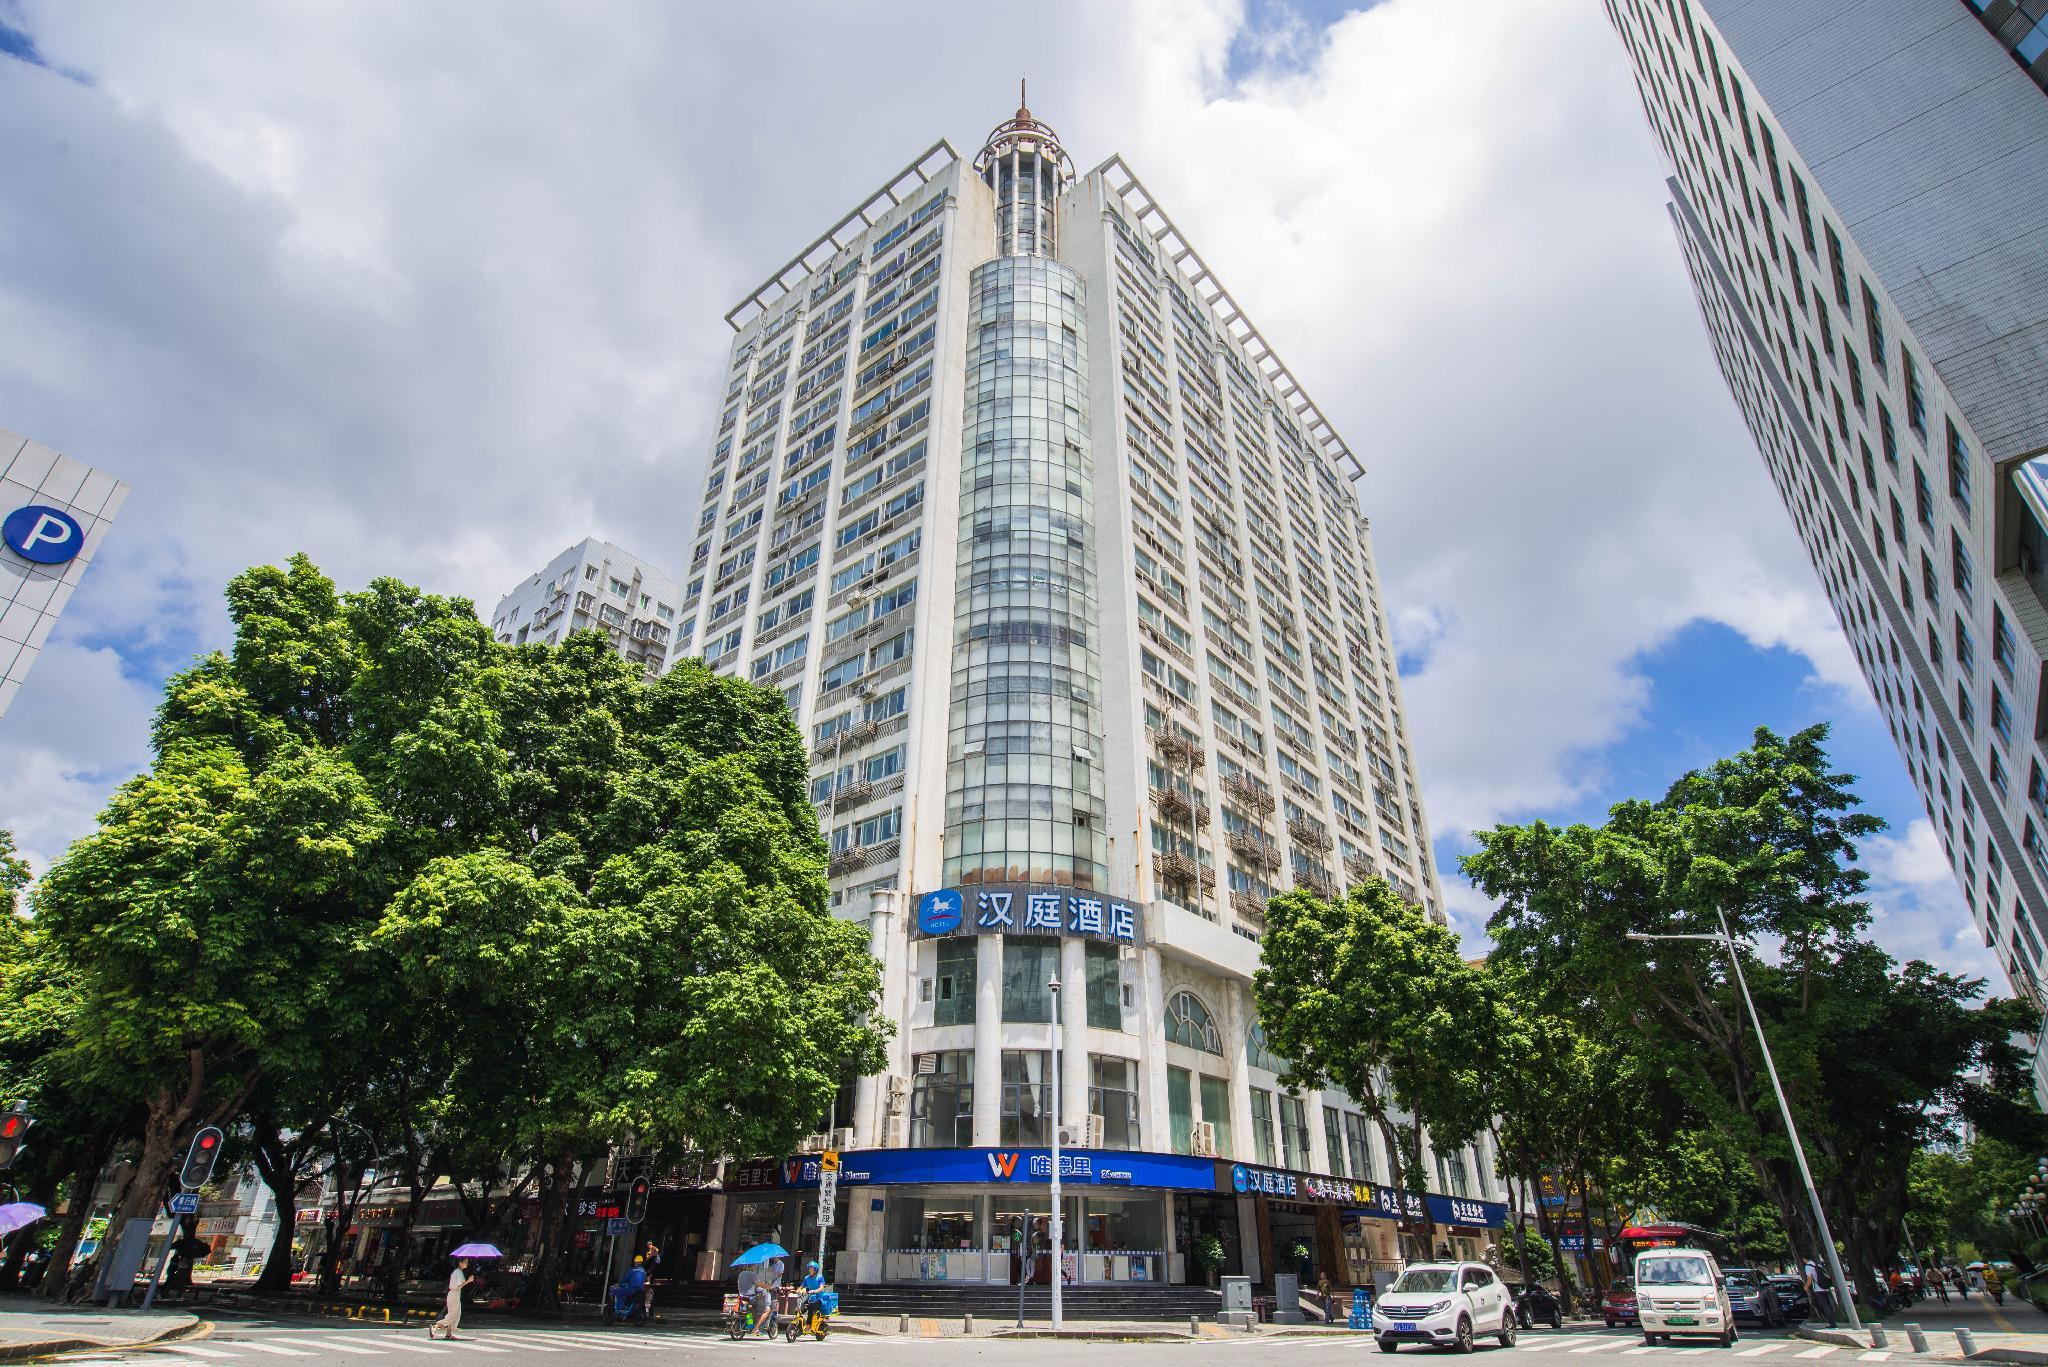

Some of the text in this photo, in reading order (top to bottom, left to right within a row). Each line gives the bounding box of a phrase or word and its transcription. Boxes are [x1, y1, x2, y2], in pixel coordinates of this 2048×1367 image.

[22, 513, 72, 551] P
[977, 891, 1135, 940] 汉庭酒店
[739, 1168, 773, 1187] 百里汇
[1030, 1155, 1092, 1177] 唯德里
[1249, 1169, 1297, 1196] 汉庭酒店
[1391, 1191, 1421, 1211] 交银行
